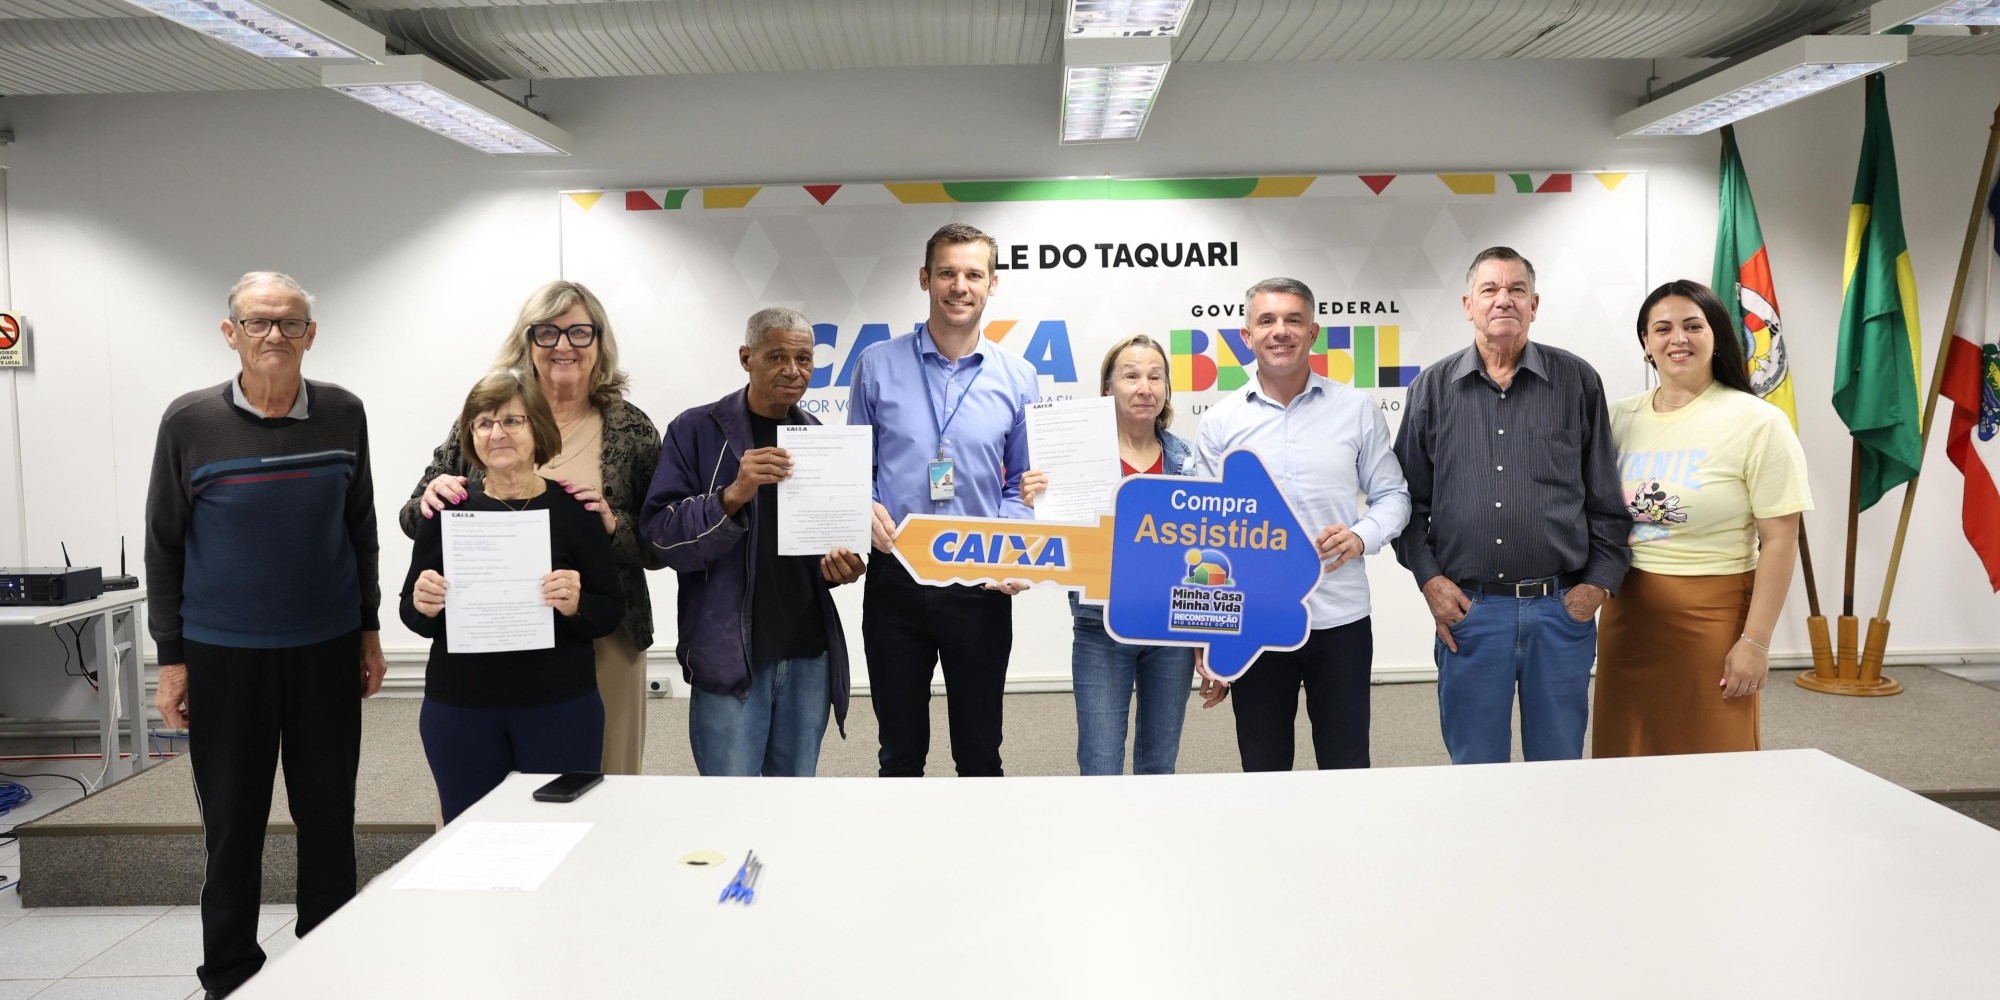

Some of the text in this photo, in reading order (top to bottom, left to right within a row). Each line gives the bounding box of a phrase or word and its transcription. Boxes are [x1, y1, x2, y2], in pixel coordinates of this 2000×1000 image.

[995, 241, 1238, 270] LE DO TAQUARI
[1191, 301, 1399, 317] GOVE EDERAL
[1170, 325, 1420, 392] BRSIL
[800, 400, 829, 413] POR
[1171, 489, 1257, 517] Compra
[1134, 513, 1287, 551] Assistida
[932, 532, 1066, 567] CAIXA
[1172, 588, 1243, 602] Minha Casa
[1172, 600, 1241, 613] Minha Vida
[1174, 613, 1238, 625] RECONSTRUÇÃO
